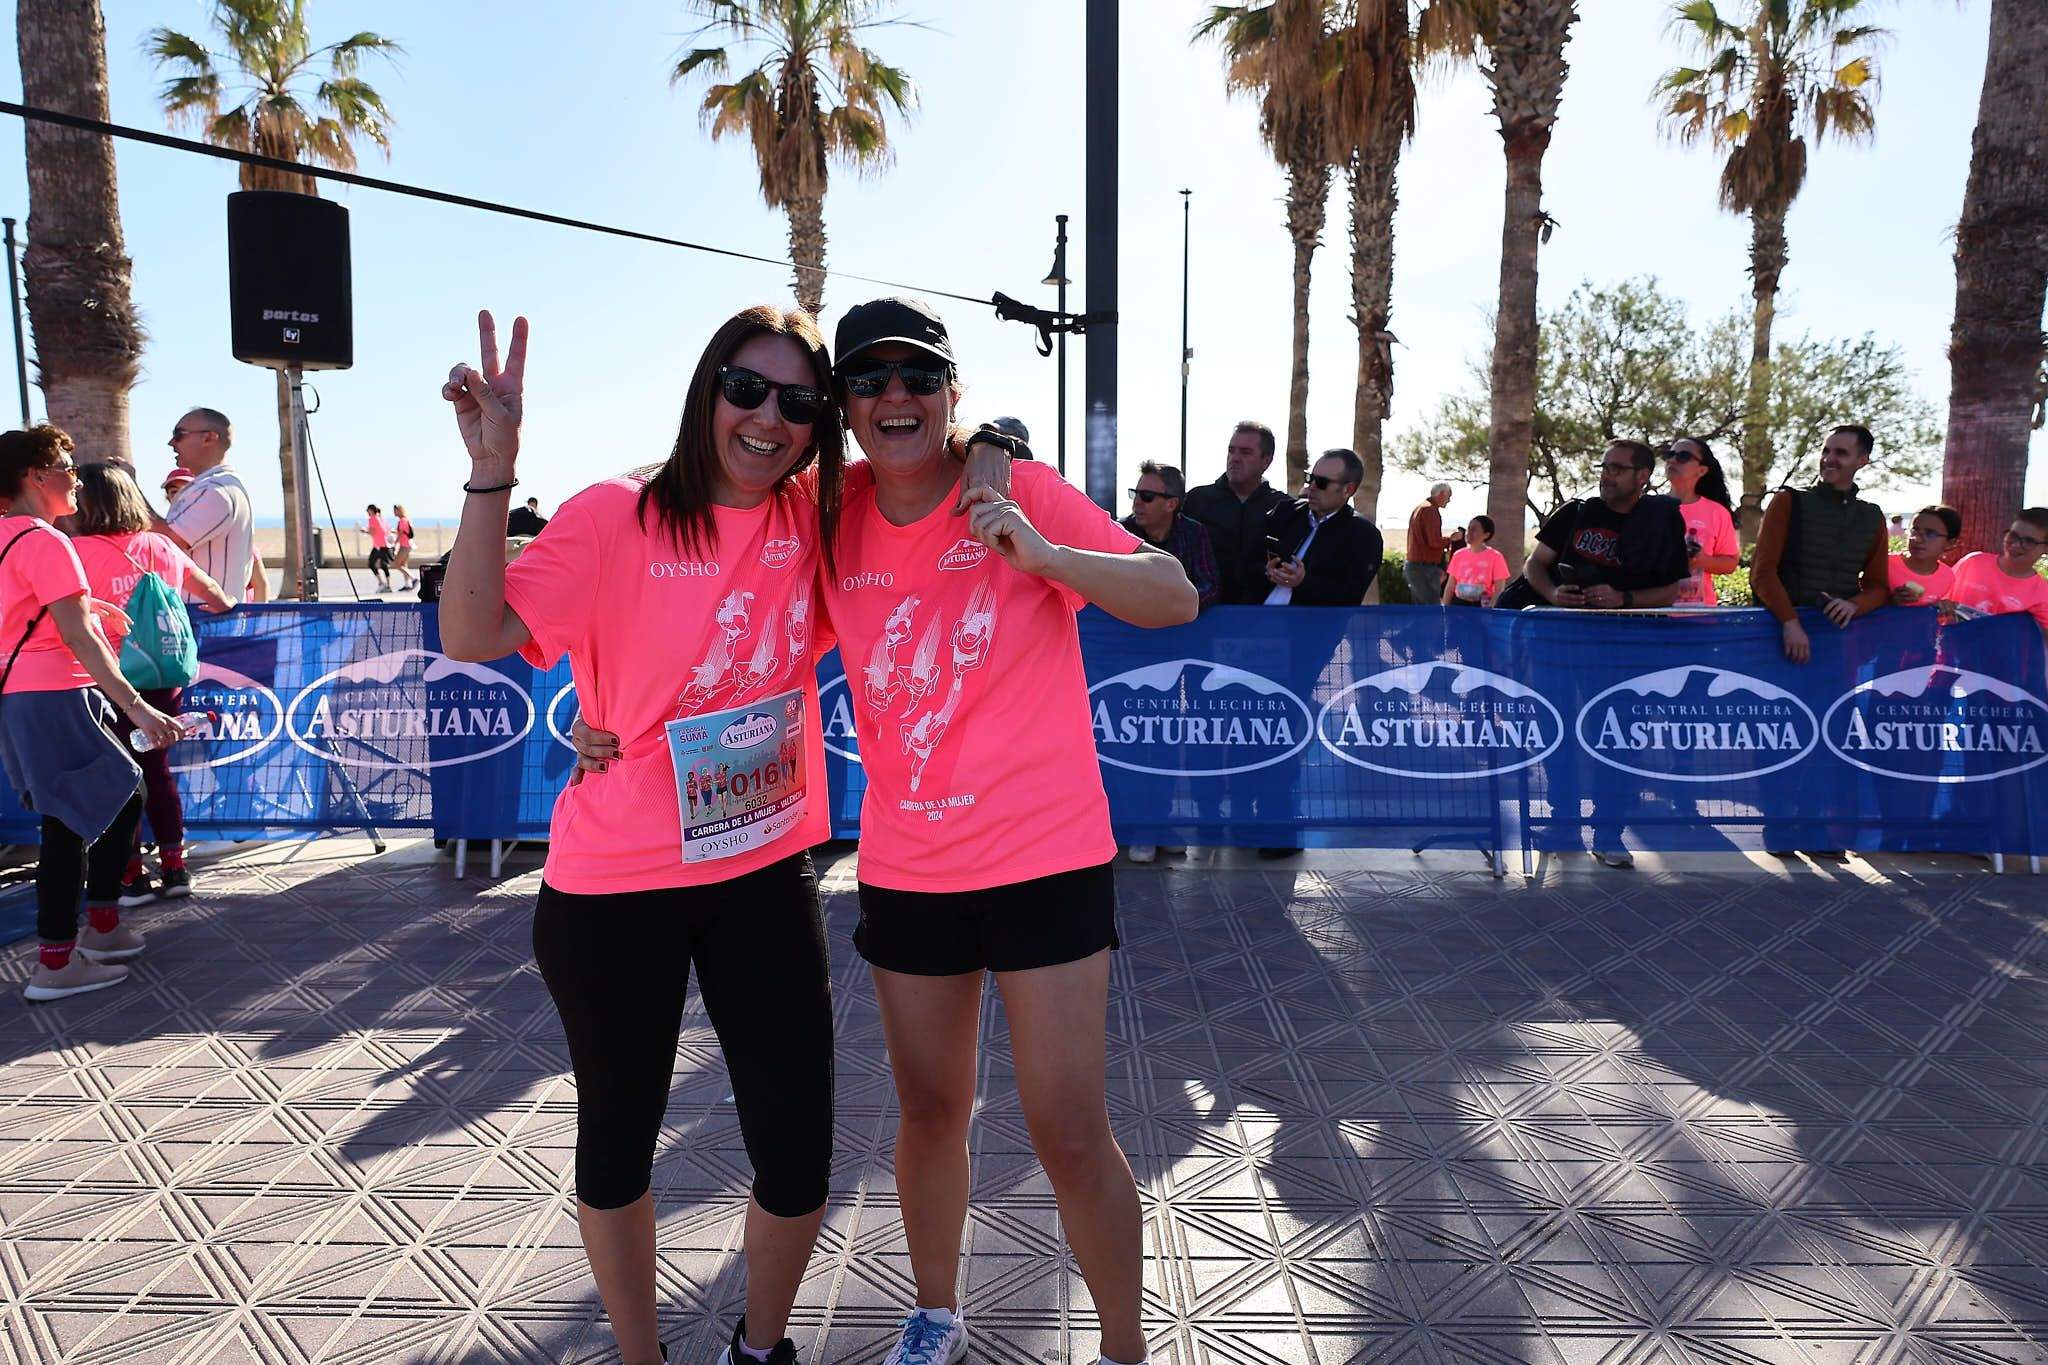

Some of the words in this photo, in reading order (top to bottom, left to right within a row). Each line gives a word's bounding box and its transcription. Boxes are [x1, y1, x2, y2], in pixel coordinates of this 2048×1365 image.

[650, 561, 720, 577] OYSHO
[843, 572, 894, 591] OYSHO
[344, 691, 419, 702] CENTRAL
[429, 690, 508, 701] LECHERA
[1123, 698, 1201, 710] CENTRAL
[1209, 699, 1287, 711] LECHERA
[1374, 701, 1451, 713] CENTRAL
[1459, 702, 1537, 714] LECHERA
[1631, 704, 1709, 716] CENTRAL
[1716, 705, 1792, 716] LECHERA
[1876, 705, 1951, 716] CENTRAL
[1958, 706, 2035, 719] LECHERA
[302, 694, 515, 738] ASTURIANA
[1092, 699, 1296, 745] ASTURIANA
[724, 723, 774, 745] ASTURIANA
[1335, 703, 1547, 749] ASTURIANA
[1594, 706, 1802, 750] ASTURIANA
[1841, 706, 2045, 753] ASTURIANA
[680, 731, 709, 744] SUMA
[745, 795, 768, 811] 6032
[925, 800, 937, 810] DE
[937, 798, 948, 809] LA
[947, 794, 976, 808] MUJER
[691, 821, 731, 838] CARRERA
[731, 817, 742, 828] DE
[742, 814, 753, 824] LA
[754, 804, 777, 821] MUJER
[926, 810, 944, 822] 2024
[701, 832, 749, 853] OYSHO
